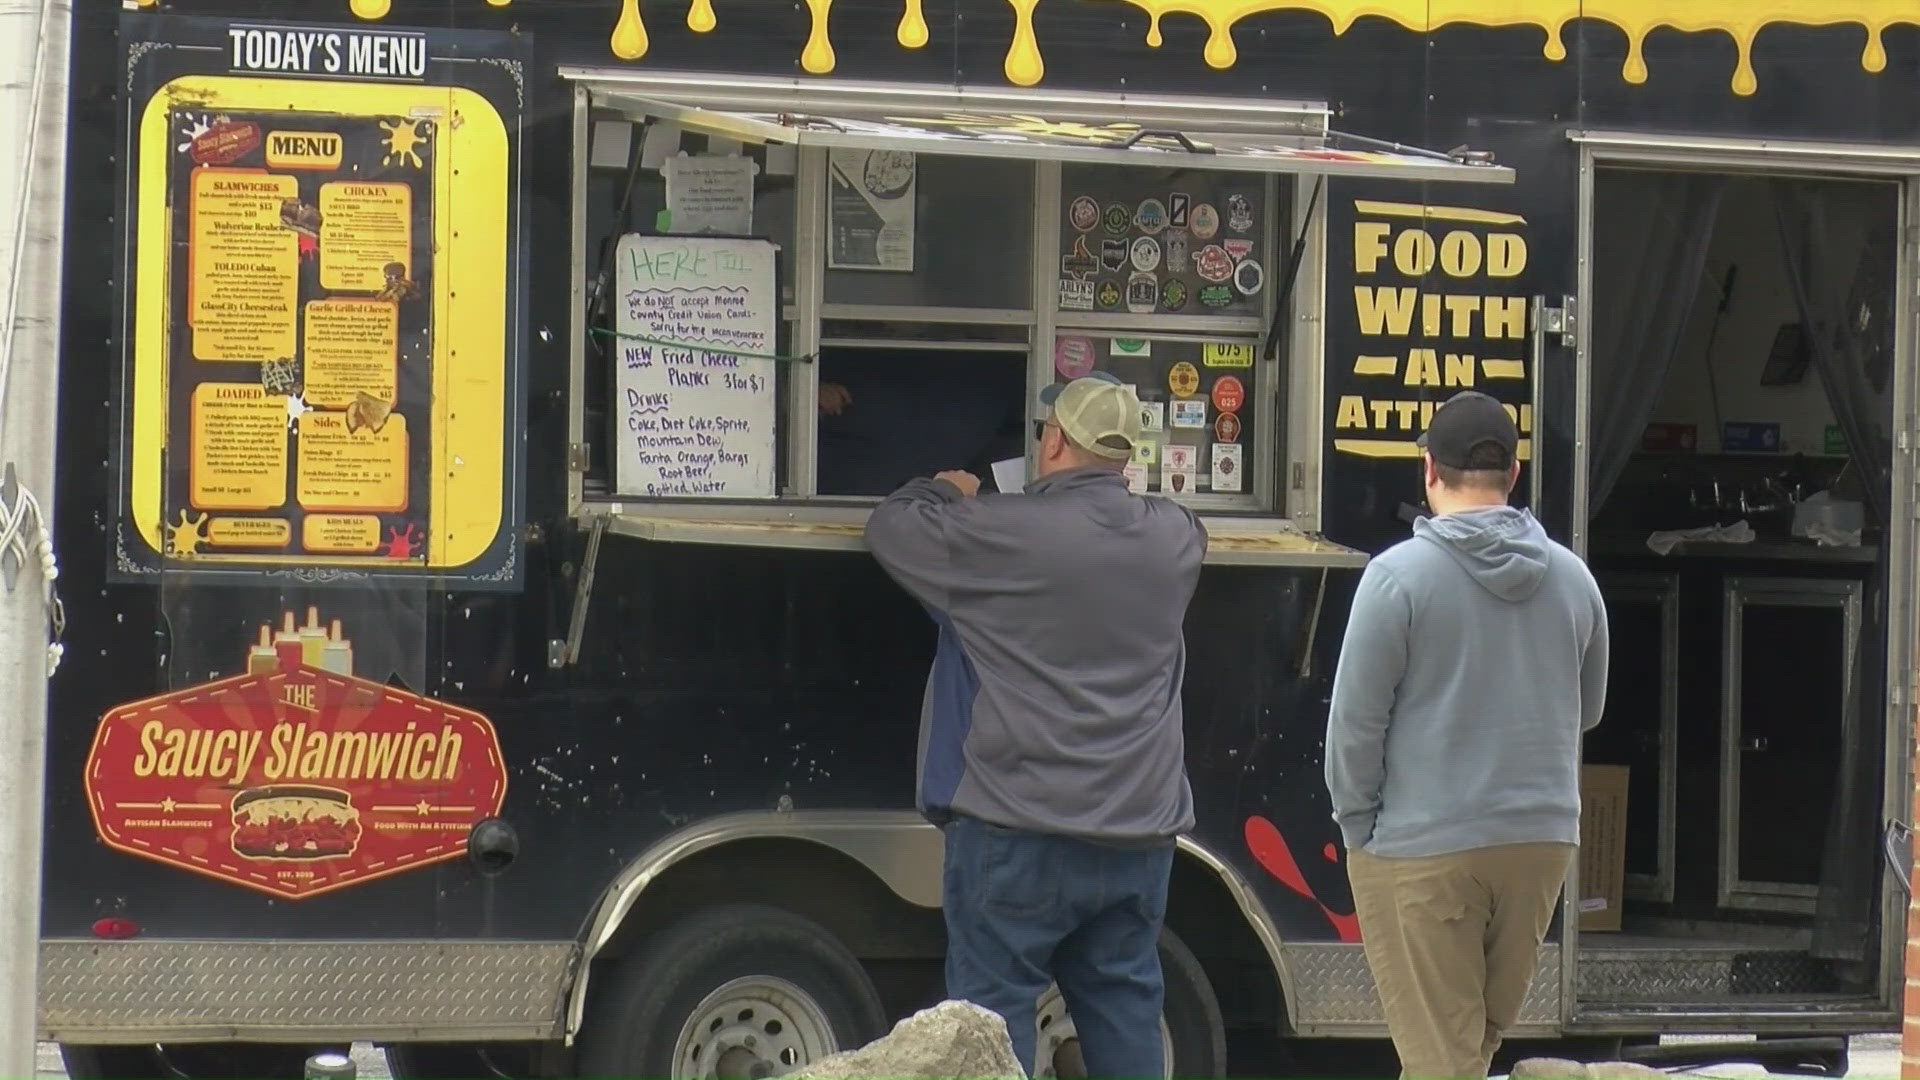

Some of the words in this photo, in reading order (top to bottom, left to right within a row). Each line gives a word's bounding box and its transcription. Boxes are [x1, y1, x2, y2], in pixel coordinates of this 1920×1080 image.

[229, 29, 341, 72] TODAY'S
[349, 35, 426, 76] MENU
[273, 136, 337, 156] MENU
[214, 182, 280, 192] SLAMWICHES
[344, 187, 387, 196] CHICKEN
[1354, 222, 1527, 277] FOOD
[214, 263, 249, 271] TOLEDO
[251, 263, 276, 272] Cuban
[630, 247, 707, 281] HERE
[240, 302, 288, 312] Cheesesteak
[310, 304, 333, 313] Garlic
[335, 304, 362, 313] Grilled
[364, 305, 392, 314] Cheese
[628, 298, 640, 308] We
[644, 296, 656, 306] do
[658, 295, 674, 307] NOT
[681, 296, 709, 308] accept
[715, 296, 744, 306] Monroe
[630, 310, 664, 325] County
[668, 310, 692, 320] Credit
[698, 310, 721, 320] Union
[1354, 286, 1526, 339] WITH
[650, 322, 674, 338] Sorry
[677, 322, 689, 334] for
[692, 323, 705, 335] the
[626, 346, 652, 362] NEW
[662, 348, 694, 365] Fried
[701, 350, 739, 367] Cheese
[1404, 348, 1474, 387] AN
[216, 388, 262, 399] LOADED
[1221, 398, 1236, 406] 025
[314, 417, 341, 428] Sides
[629, 417, 659, 432] Coke,
[662, 417, 684, 430] Diet
[689, 416, 715, 432] Coke,
[716, 416, 750, 434] Sprite,
[637, 435, 694, 449] Mountain
[697, 433, 724, 449] Dew,
[639, 451, 672, 465] Fanta
[678, 451, 716, 468] Orange,
[659, 467, 683, 479] Root
[685, 465, 712, 479] Beer,
[647, 482, 690, 496] Bottled
[692, 481, 725, 493] Water
[284, 684, 316, 709] THE
[134, 719, 262, 784] Saucy
[264, 722, 463, 780] Slamwich
